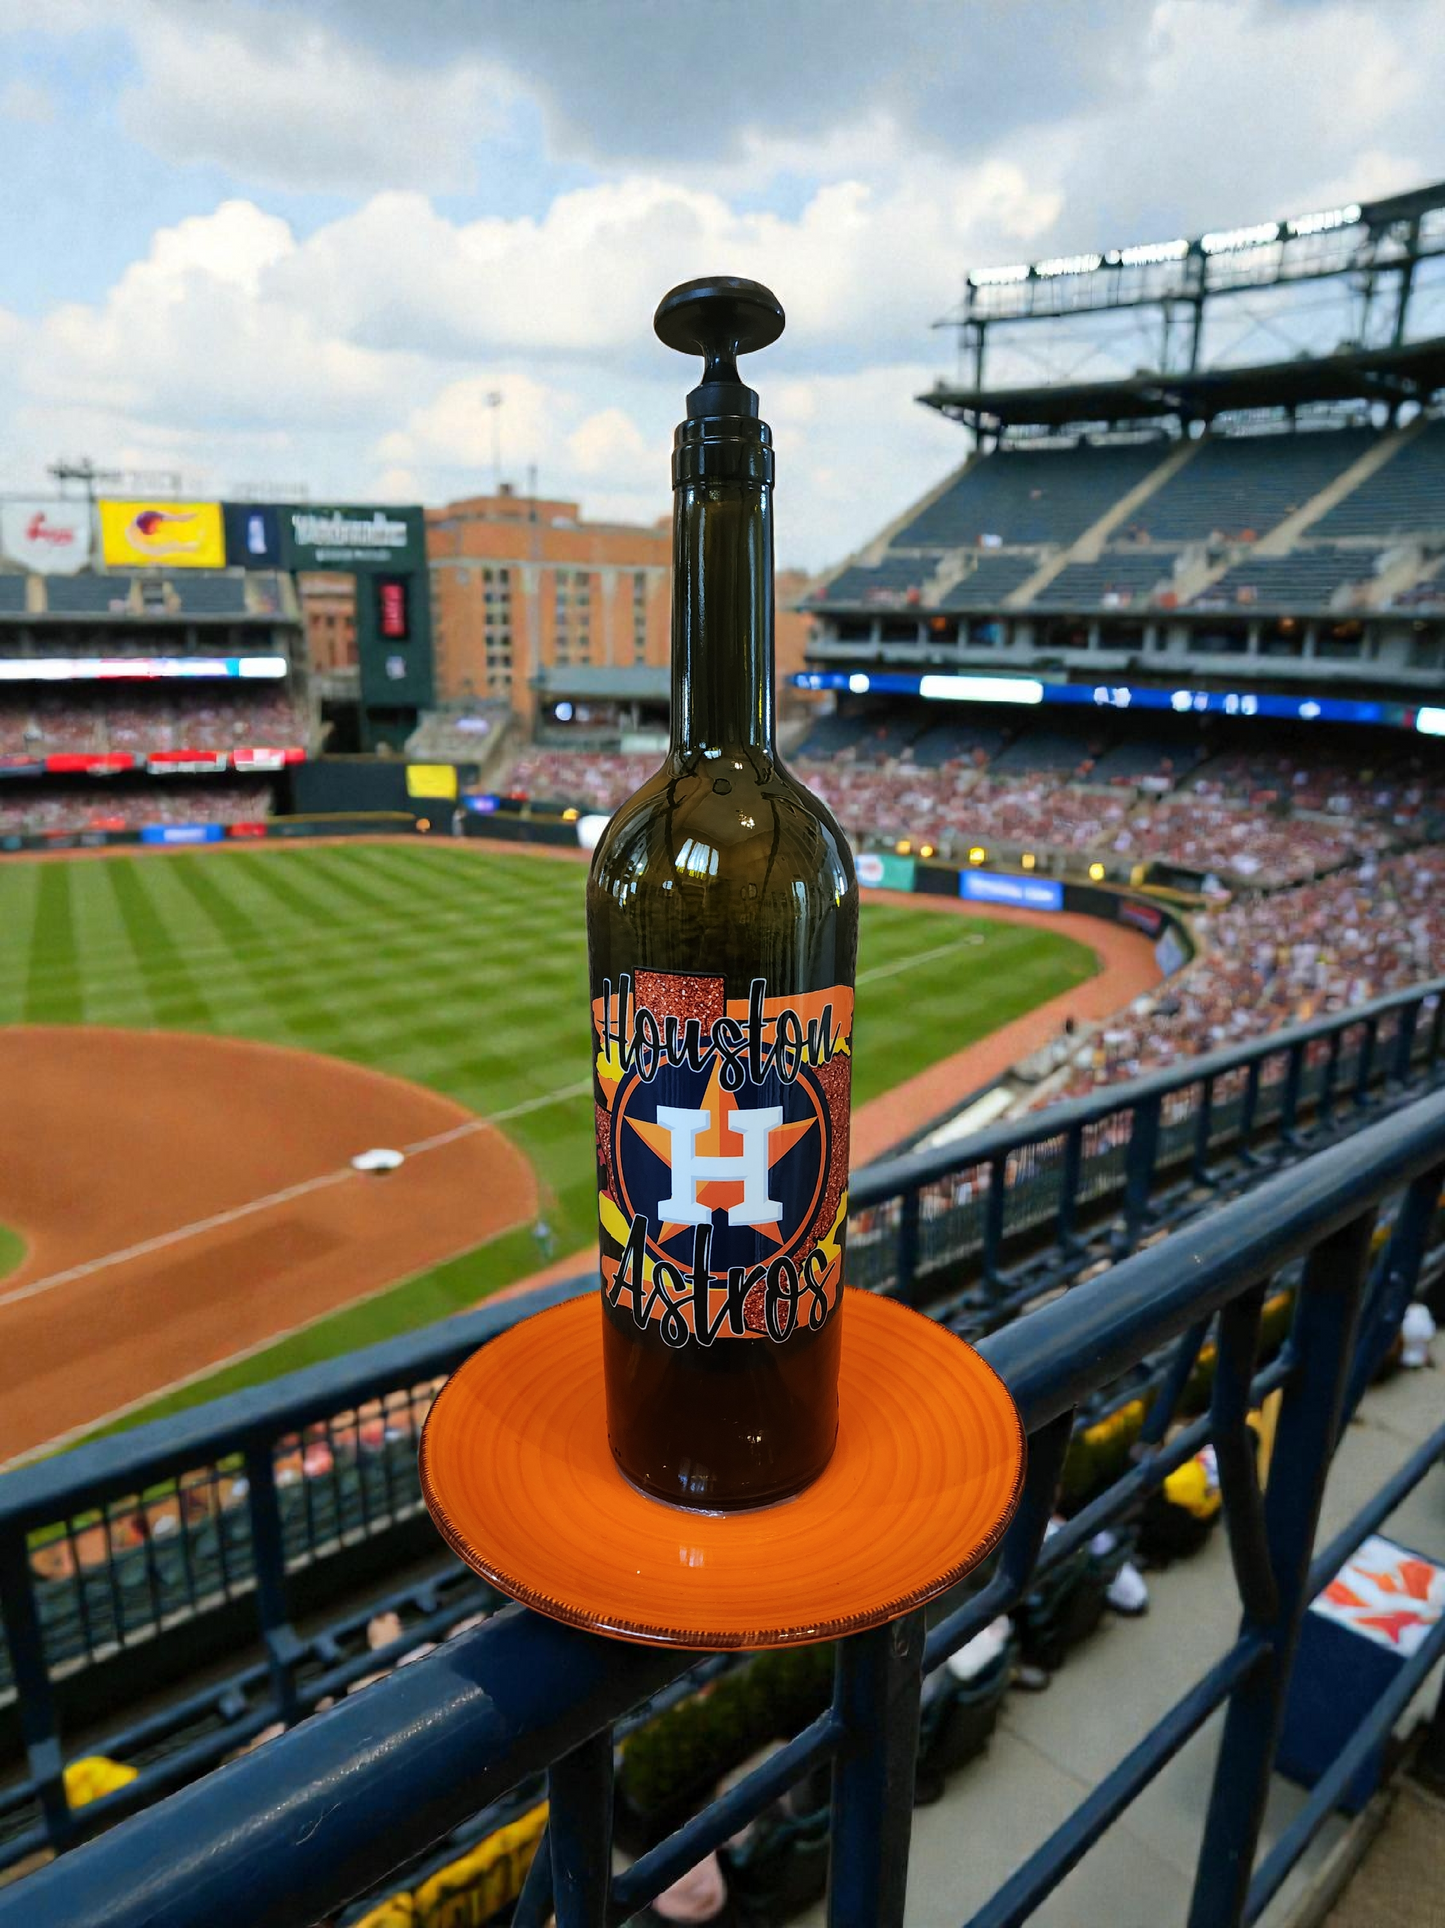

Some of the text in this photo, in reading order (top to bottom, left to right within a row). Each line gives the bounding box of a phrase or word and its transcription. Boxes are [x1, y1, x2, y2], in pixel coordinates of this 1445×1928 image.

[597, 973, 841, 1092] Houston
[656, 1105, 784, 1227] H
[609, 1213, 837, 1349] Astros
